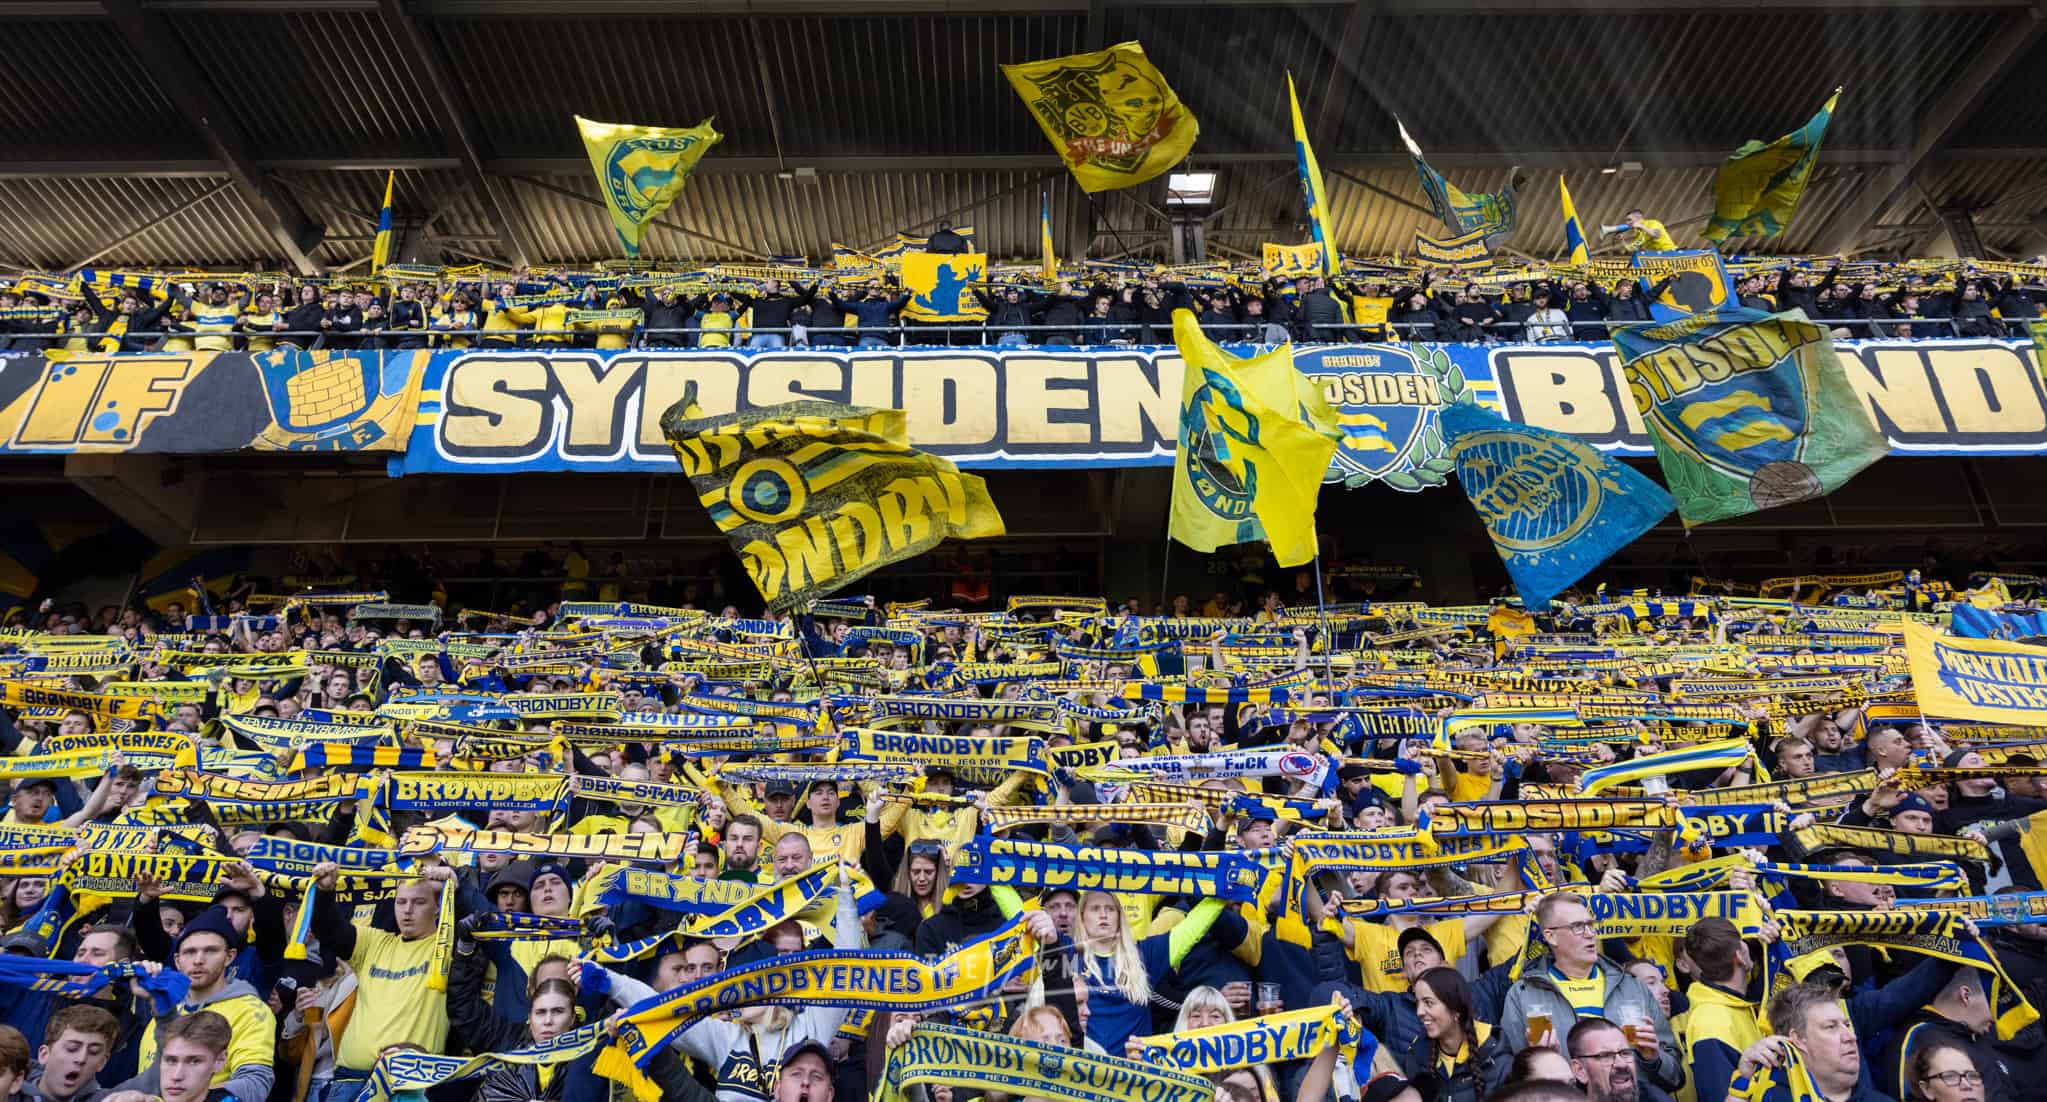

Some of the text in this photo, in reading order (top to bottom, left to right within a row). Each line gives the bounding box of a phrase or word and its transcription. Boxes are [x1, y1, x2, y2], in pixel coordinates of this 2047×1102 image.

[1069, 106, 1102, 133] BVB
[1072, 139, 1105, 152] THE
[1702, 257, 1714, 267] OS
[14, 360, 190, 447] IF
[48, 653, 122, 668] BRØNDBY
[250, 655, 294, 666] FCK
[1446, 673, 1583, 694] THE UNITY
[25, 687, 103, 710] BRØNDBY
[109, 697, 126, 714] IF
[597, 696, 617, 711] IF
[886, 702, 1029, 719] BRØNDBY IF
[872, 732, 1014, 755] BRØNDBY IF
[1052, 746, 1116, 768] NDBY
[1128, 756, 1268, 773] HADER FuCK
[156, 769, 358, 801] SYDSIDEN
[396, 779, 560, 801] BRØNDBY
[492, 801, 537, 809] SKILLER
[1431, 801, 1677, 831] SYDSIDEN
[1763, 812, 1787, 834] IF
[403, 826, 687, 861] SYDSIDEN
[1297, 836, 1484, 862] BRØNDBYENES
[989, 839, 1220, 898] SYDSIDEN
[797, 868, 830, 901] IF
[1582, 892, 1717, 921] ØNDBY
[1719, 893, 1750, 919] IF
[1641, 924, 1660, 934] TIL
[1779, 911, 1969, 942] BRØNDBY IF
[672, 963, 959, 1018] BRØNDBYERNES IF
[1298, 1019, 1323, 1055] IF
[902, 1034, 1029, 1072] BRØNDBY
